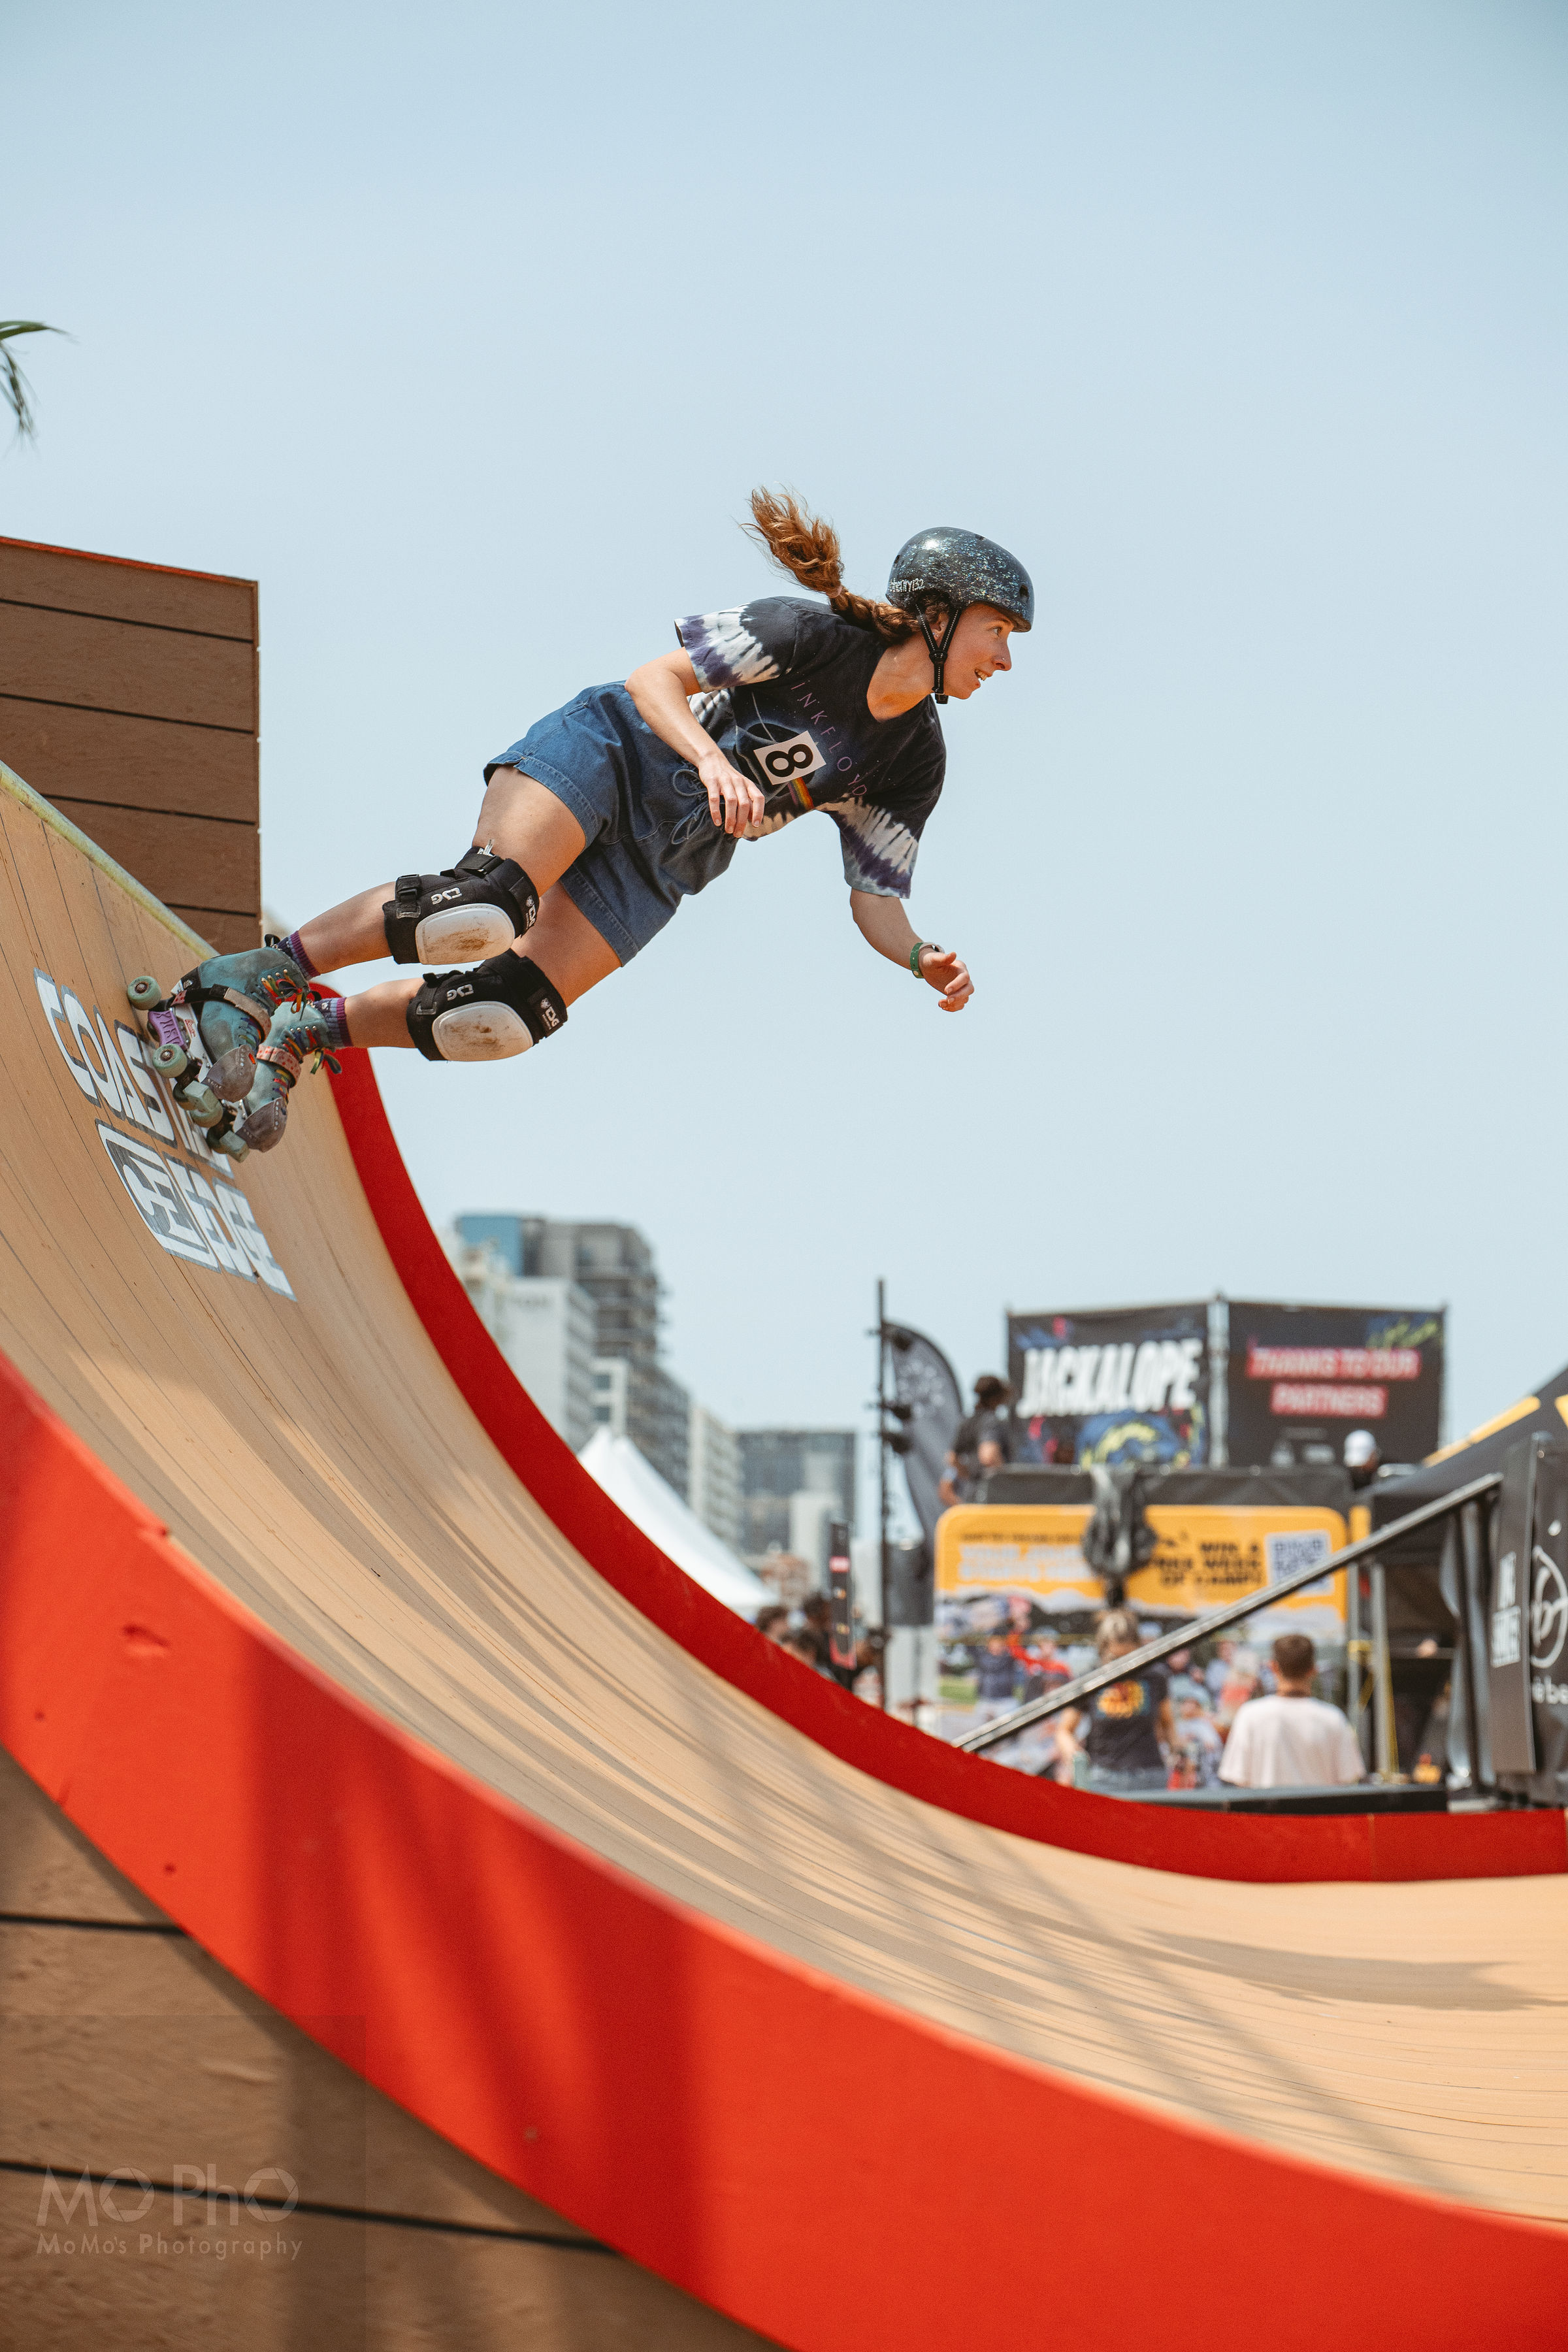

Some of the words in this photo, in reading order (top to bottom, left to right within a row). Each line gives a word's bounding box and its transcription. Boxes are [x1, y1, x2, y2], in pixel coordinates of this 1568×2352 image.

[791, 681, 828, 726] INK
[765, 743, 813, 777] 8
[1017, 1338, 1203, 1417] JACKALOPE
